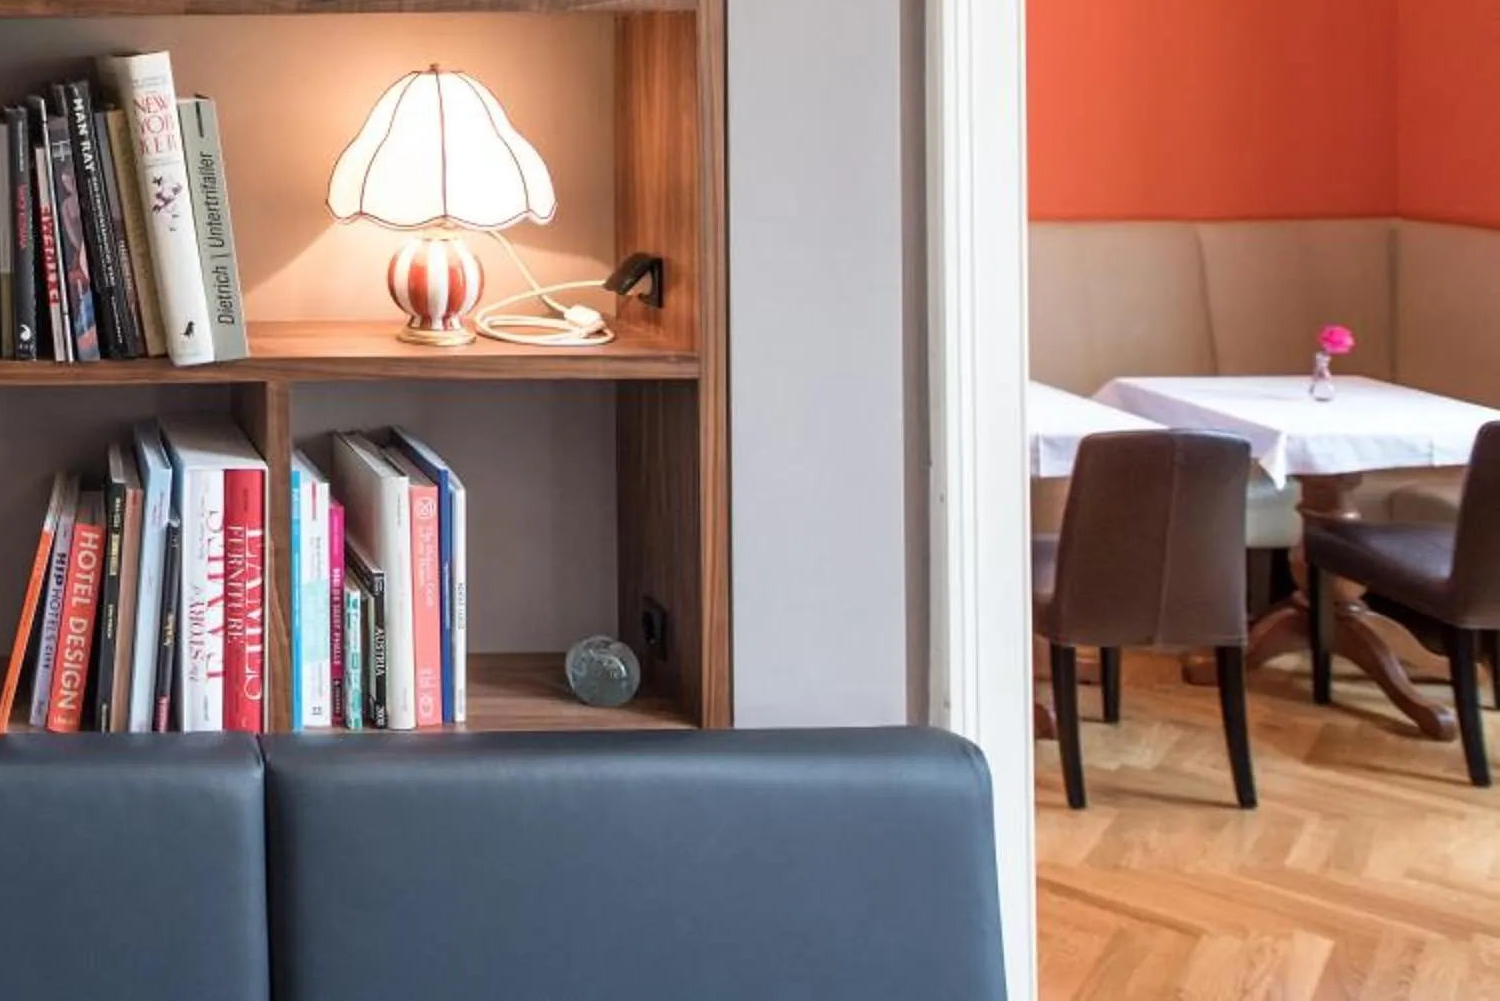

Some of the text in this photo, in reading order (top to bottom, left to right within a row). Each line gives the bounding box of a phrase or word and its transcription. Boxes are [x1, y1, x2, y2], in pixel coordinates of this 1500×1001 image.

[72, 97, 97, 172] MAN RAY
[200, 150, 235, 326] Dietrich Untertrifaller
[55, 552, 67, 587] HIP
[227, 524, 244, 644] FURNITURE
[55, 529, 100, 711] HOTEL DESIGN
[188, 599, 204, 660] STORY
[375, 626, 386, 676] AUSTRIA
